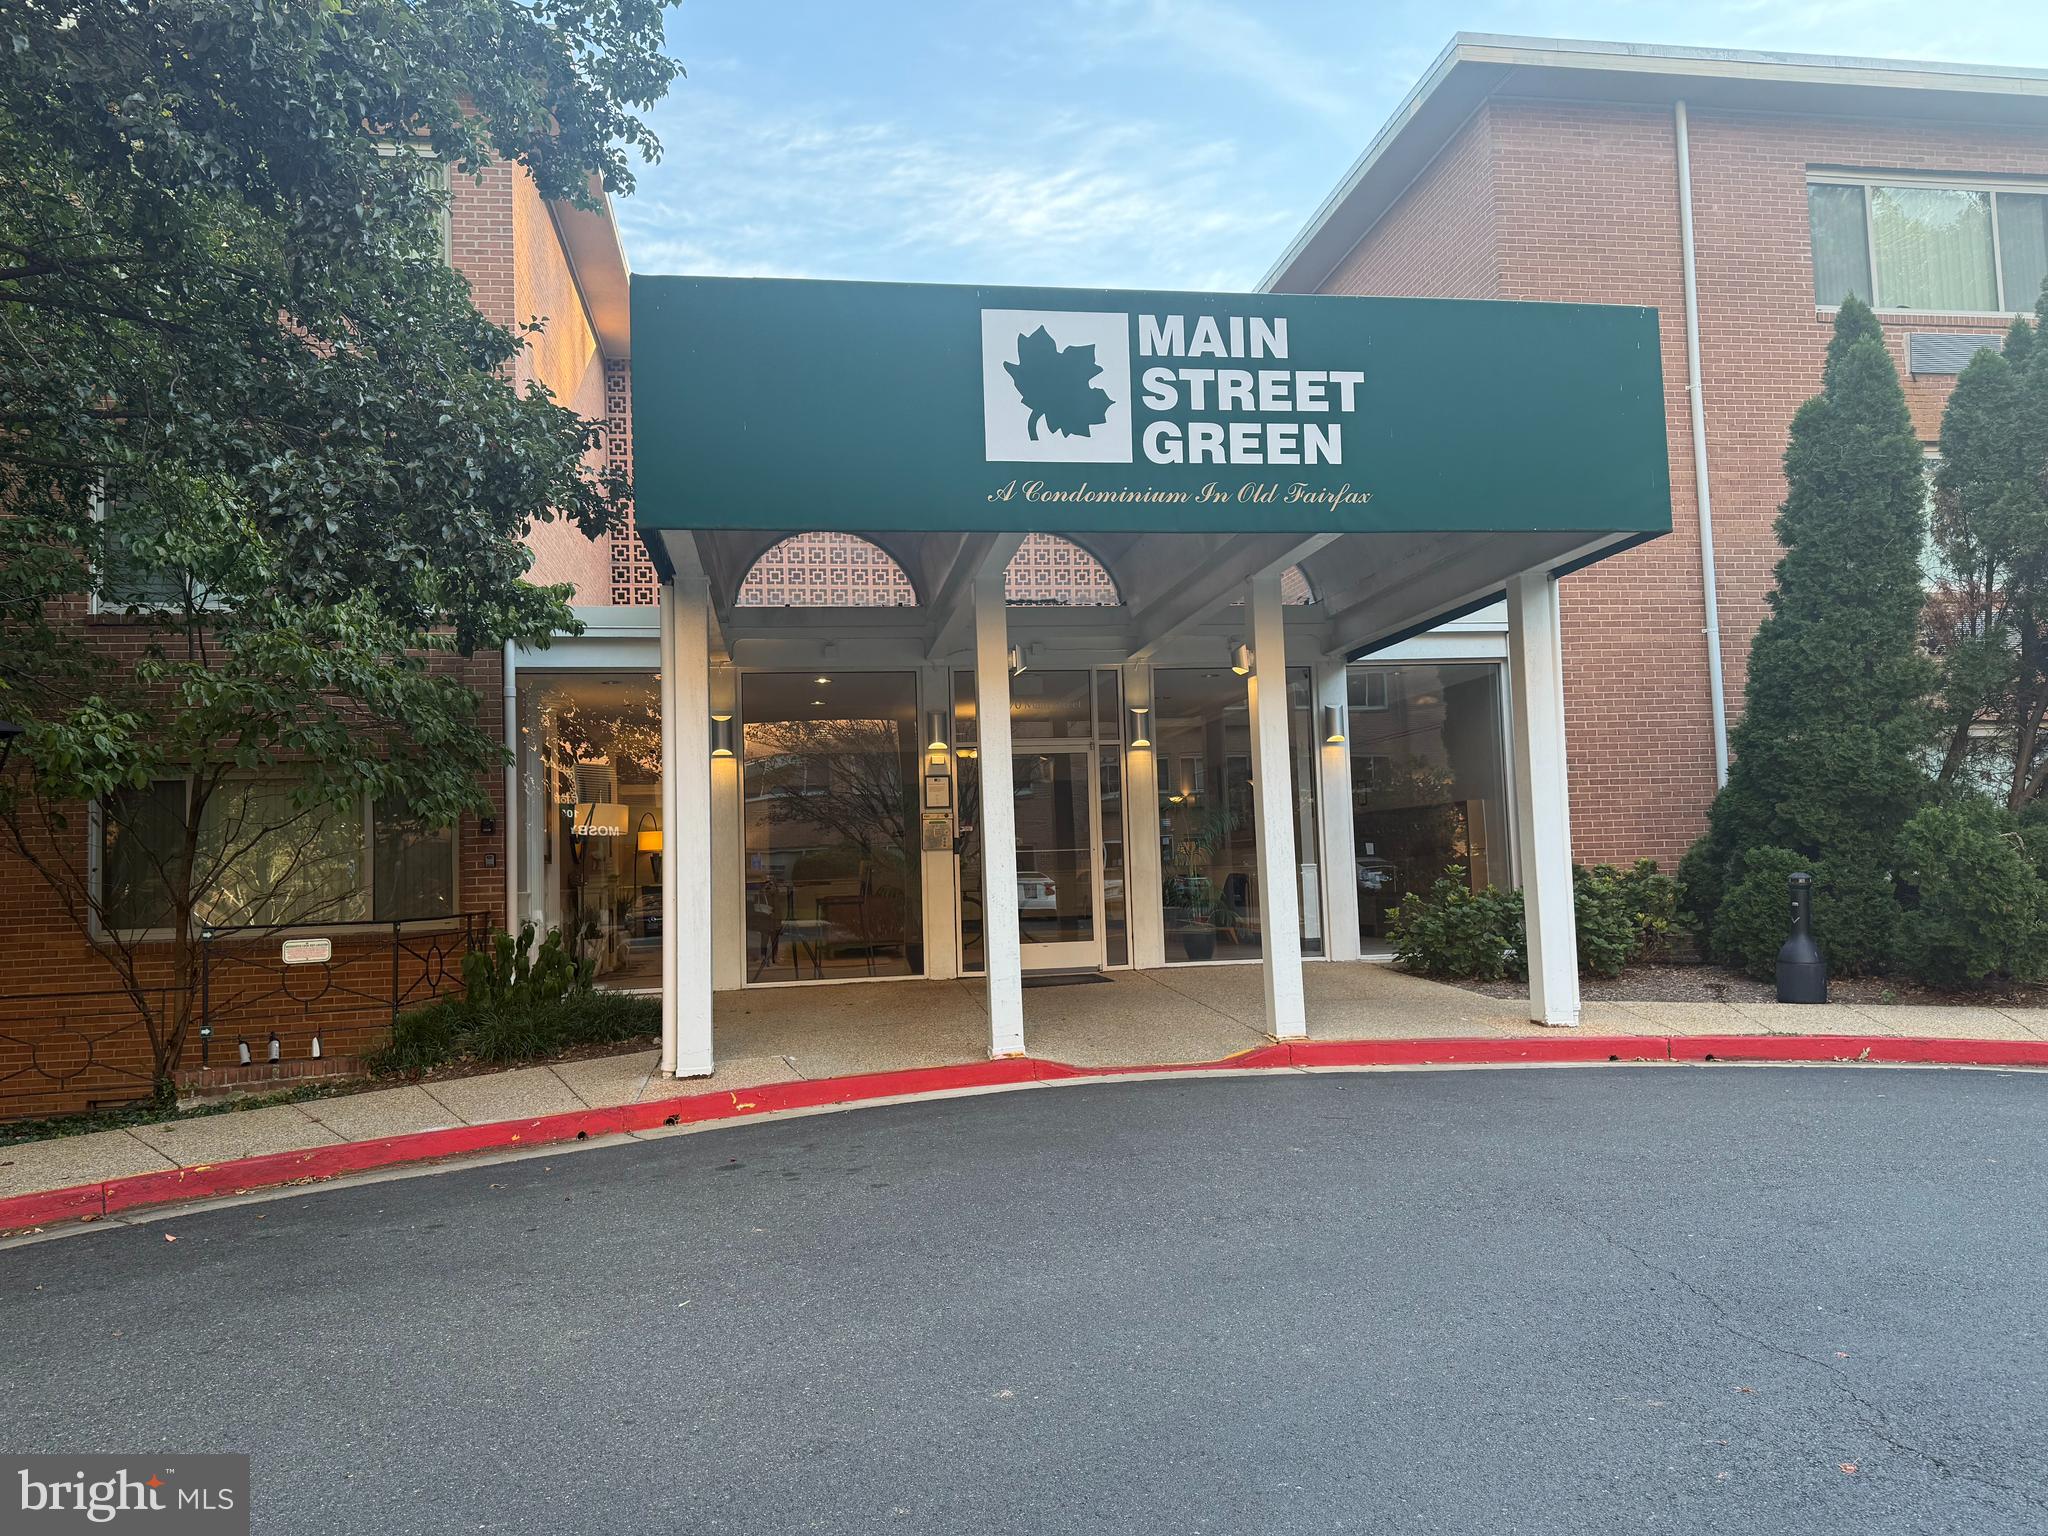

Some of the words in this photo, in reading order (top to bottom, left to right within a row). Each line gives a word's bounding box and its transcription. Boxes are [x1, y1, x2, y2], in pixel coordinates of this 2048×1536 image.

[1138, 314, 1289, 359] MAIN
[1142, 367, 1365, 412] STREET
[1142, 420, 1342, 465] GREEN
[987, 480, 1018, 502] A
[1022, 480, 1192, 503] Condominium
[1195, 481, 1234, 503] In
[1237, 481, 1280, 504] Old
[1283, 481, 1374, 512] Fairfax
